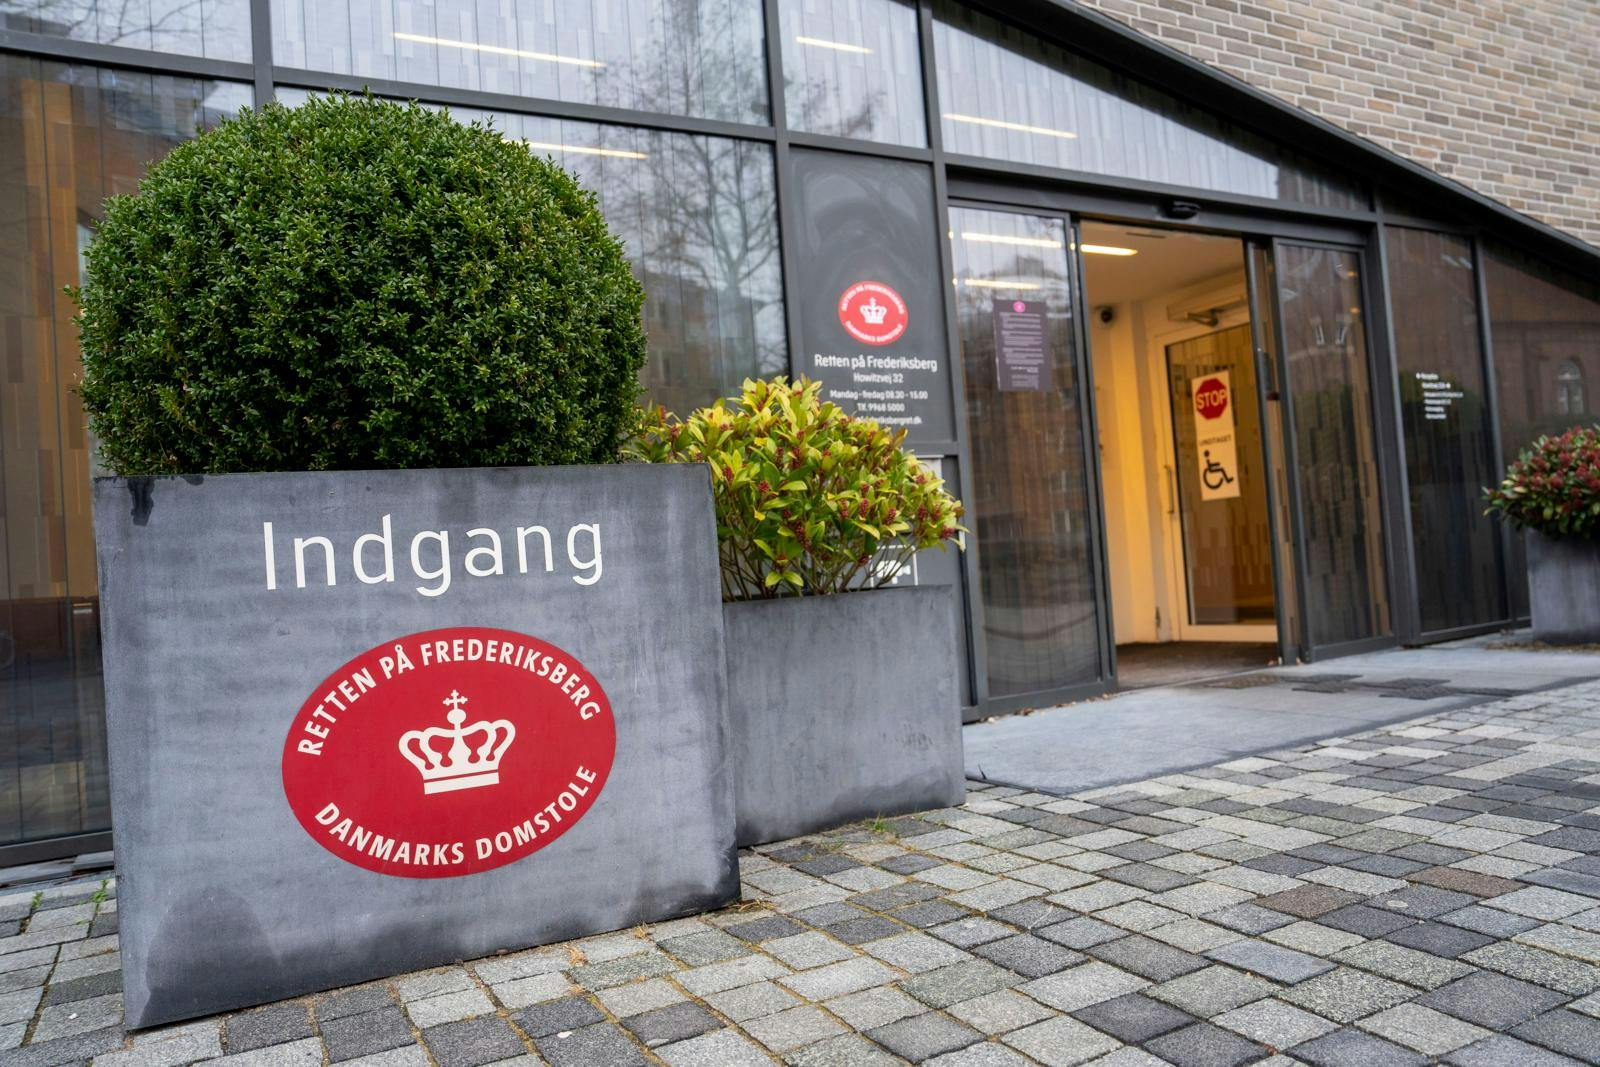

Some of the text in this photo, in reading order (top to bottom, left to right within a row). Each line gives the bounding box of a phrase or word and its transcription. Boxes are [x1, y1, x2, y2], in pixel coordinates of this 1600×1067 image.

[814, 354, 938, 372] Retten på Frederiksberg
[853, 372, 904, 384] Howitzvej 32
[829, 389, 859, 400] Mandag
[1196, 388, 1226, 410] STOP
[263, 513, 603, 597] Indgang
[297, 638, 601, 756] RETTEN PÅ FREDERIKSBERG
[314, 765, 597, 867] DANMARKS DOMSTOLE
